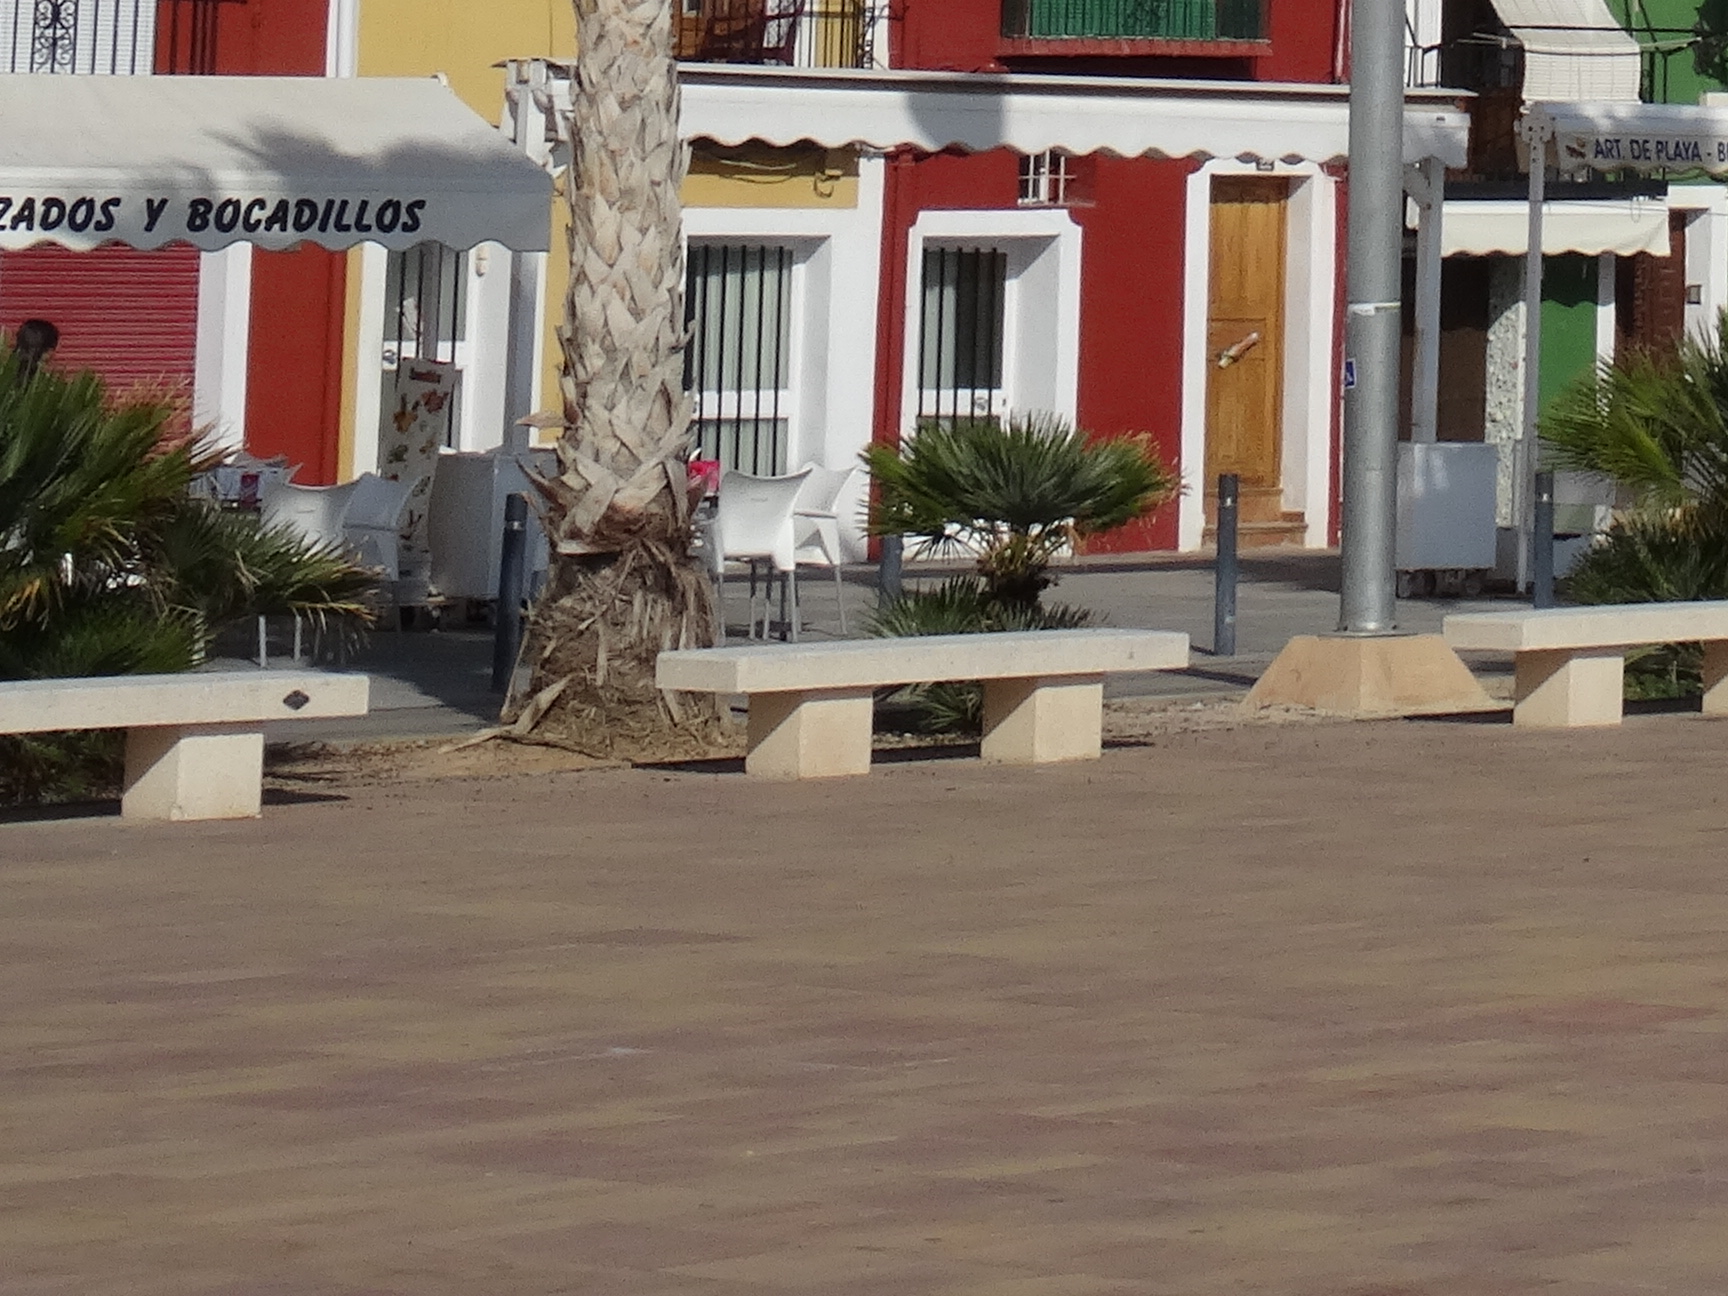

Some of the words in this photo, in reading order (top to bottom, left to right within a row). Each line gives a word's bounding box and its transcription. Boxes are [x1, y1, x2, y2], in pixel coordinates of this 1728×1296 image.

[1595, 138, 1626, 159] ART.
[1629, 139, 1649, 160] DE
[1655, 139, 1702, 163] PLAYA
[144, 198, 168, 232] Y
[186, 198, 426, 233] BOCADILLOS
